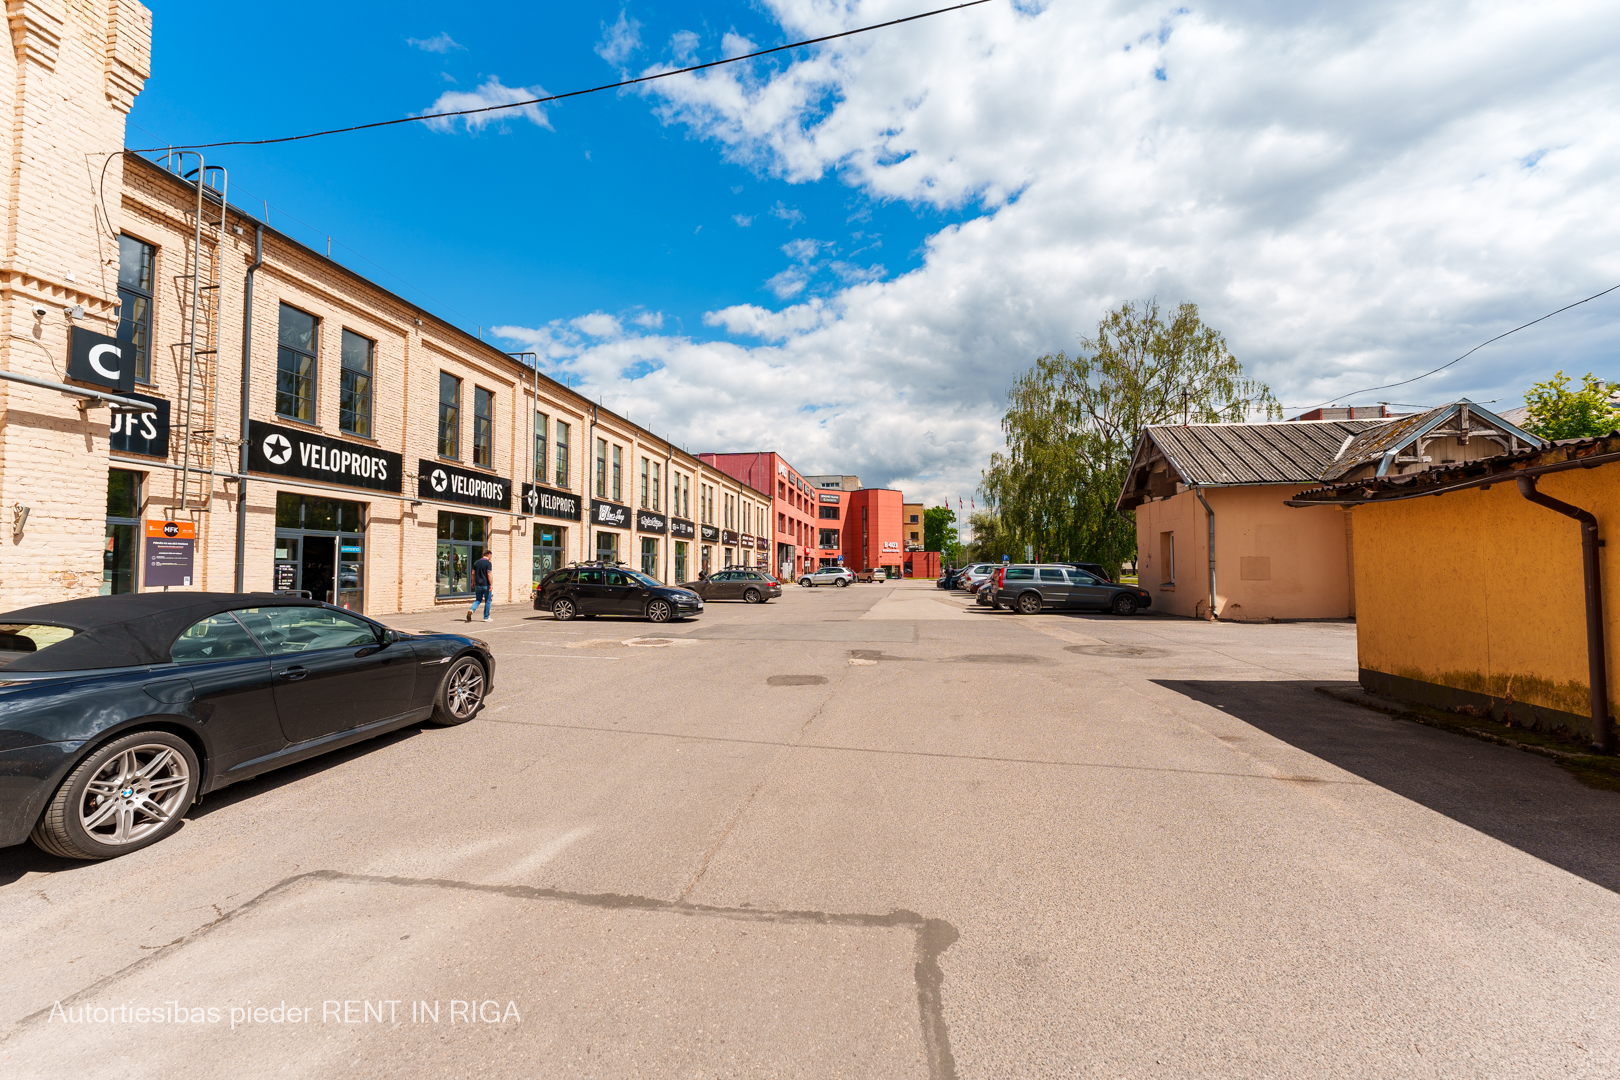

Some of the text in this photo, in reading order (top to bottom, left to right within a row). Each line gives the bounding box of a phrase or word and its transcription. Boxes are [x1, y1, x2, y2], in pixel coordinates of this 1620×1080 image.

[88, 343, 122, 380] C
[299, 441, 388, 481] VELOPROFS
[451, 474, 503, 501] VELOPROFS
[540, 493, 575, 513] VELOPROFS
